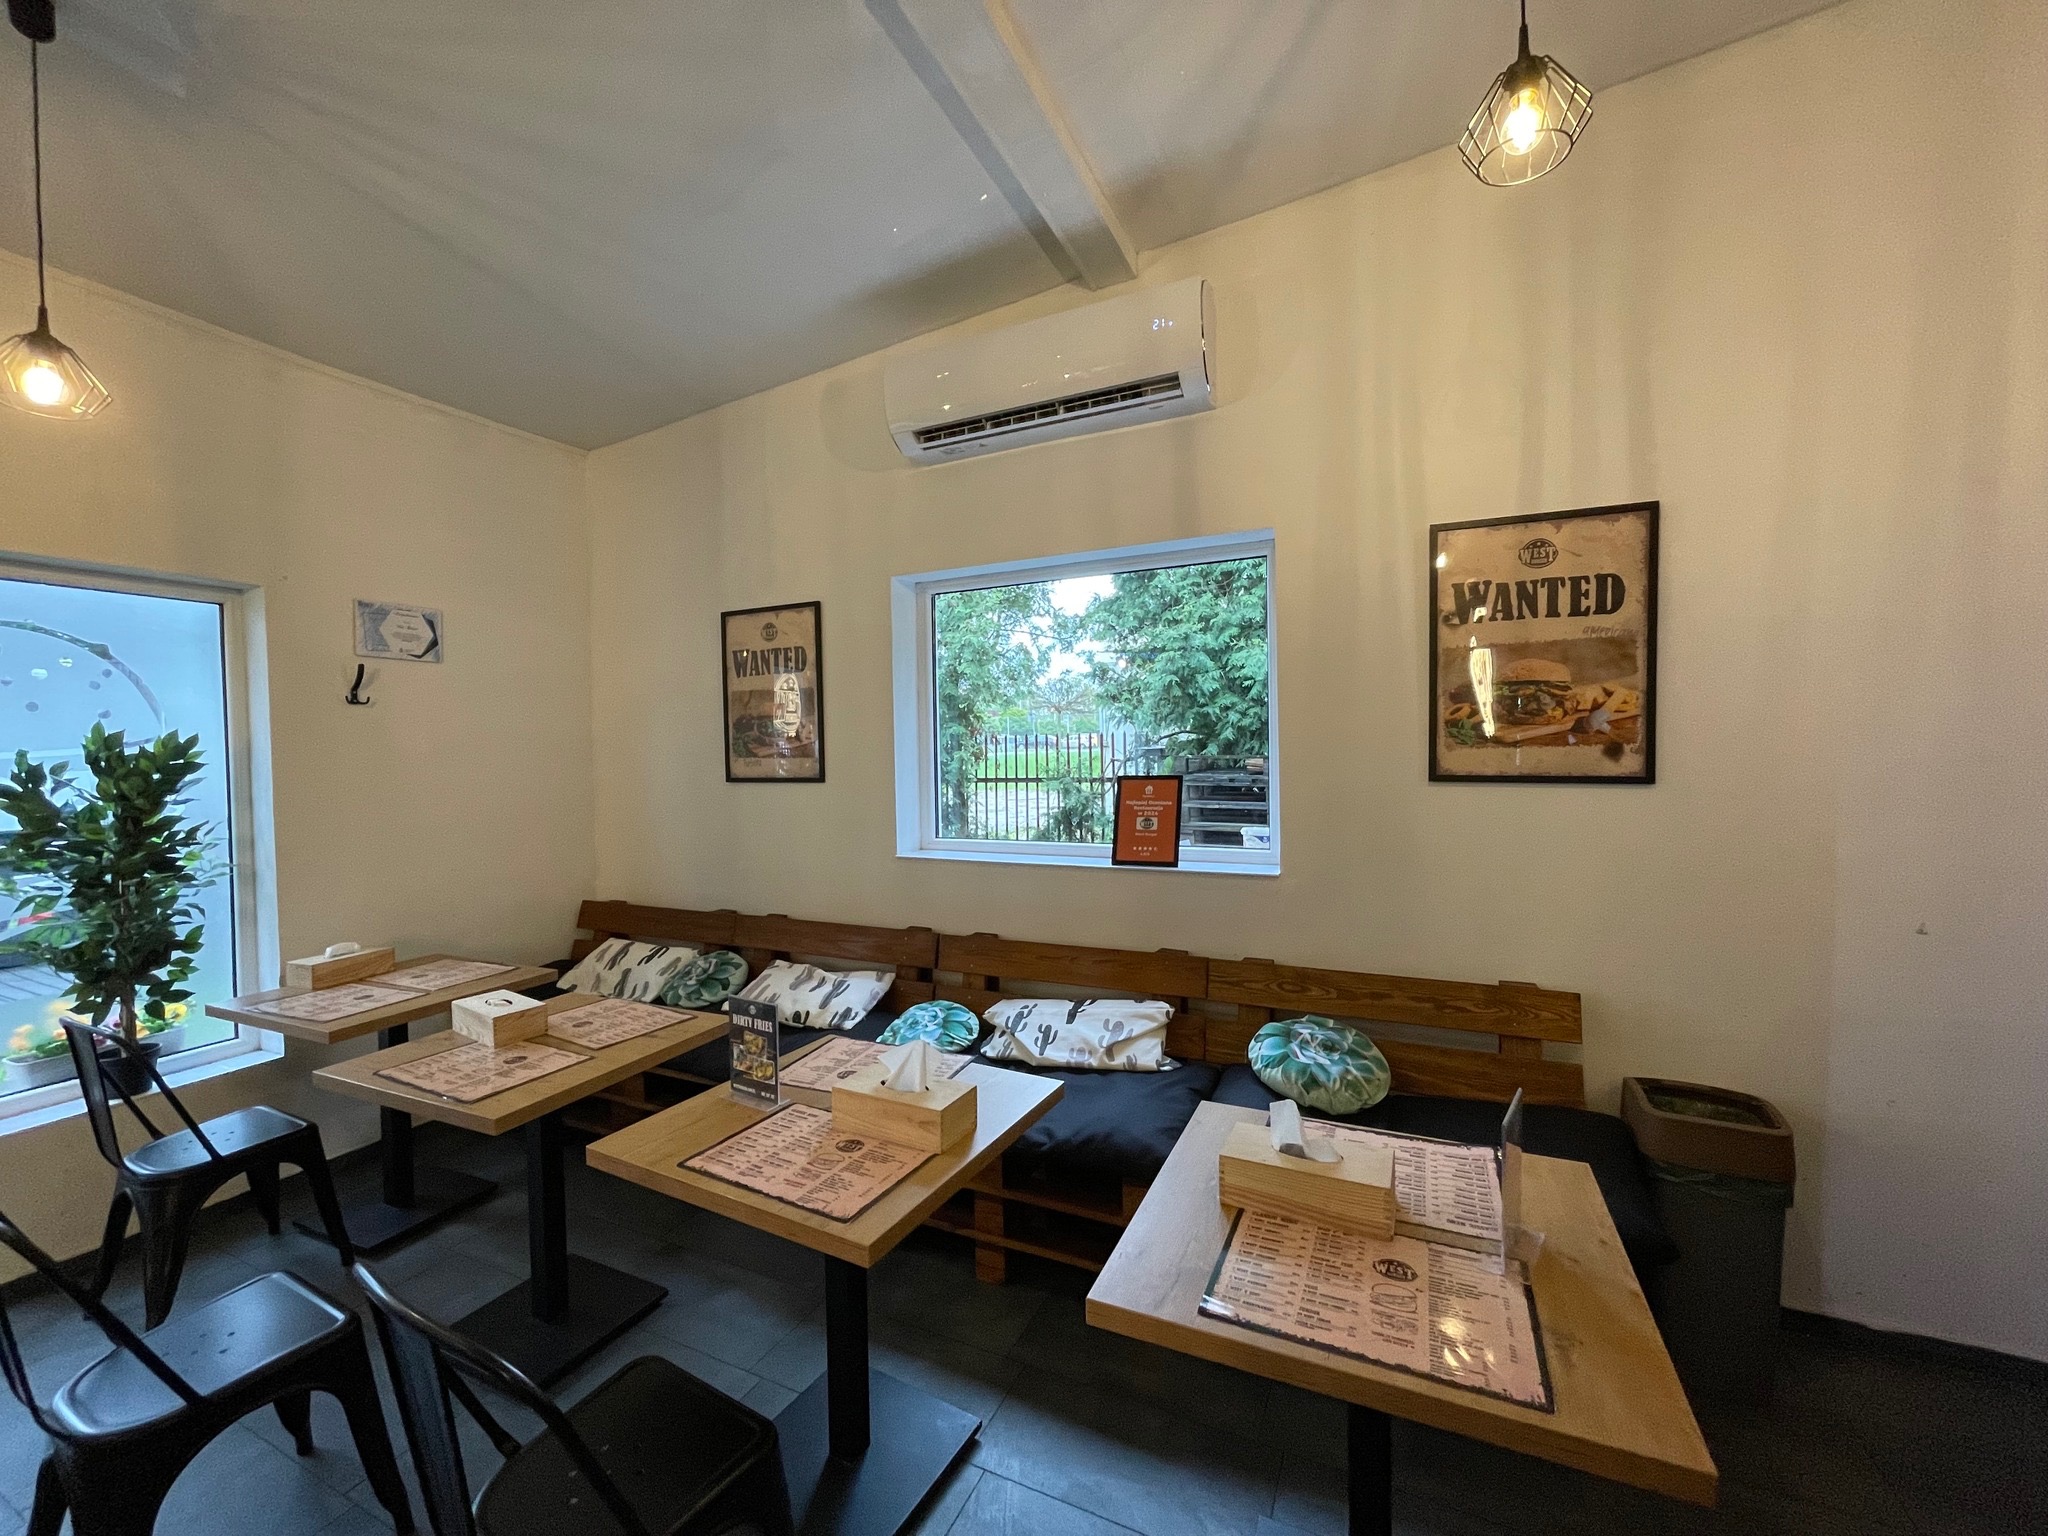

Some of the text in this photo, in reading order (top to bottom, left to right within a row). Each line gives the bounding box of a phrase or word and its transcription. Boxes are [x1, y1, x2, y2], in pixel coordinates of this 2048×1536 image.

[1519, 546, 1556, 564] WEST
[1451, 572, 1627, 626] WANTED
[731, 646, 808, 679] WANTED
[732, 1013, 773, 1033] DIRTY FRIES
[1373, 1260, 1415, 1281] WEST
